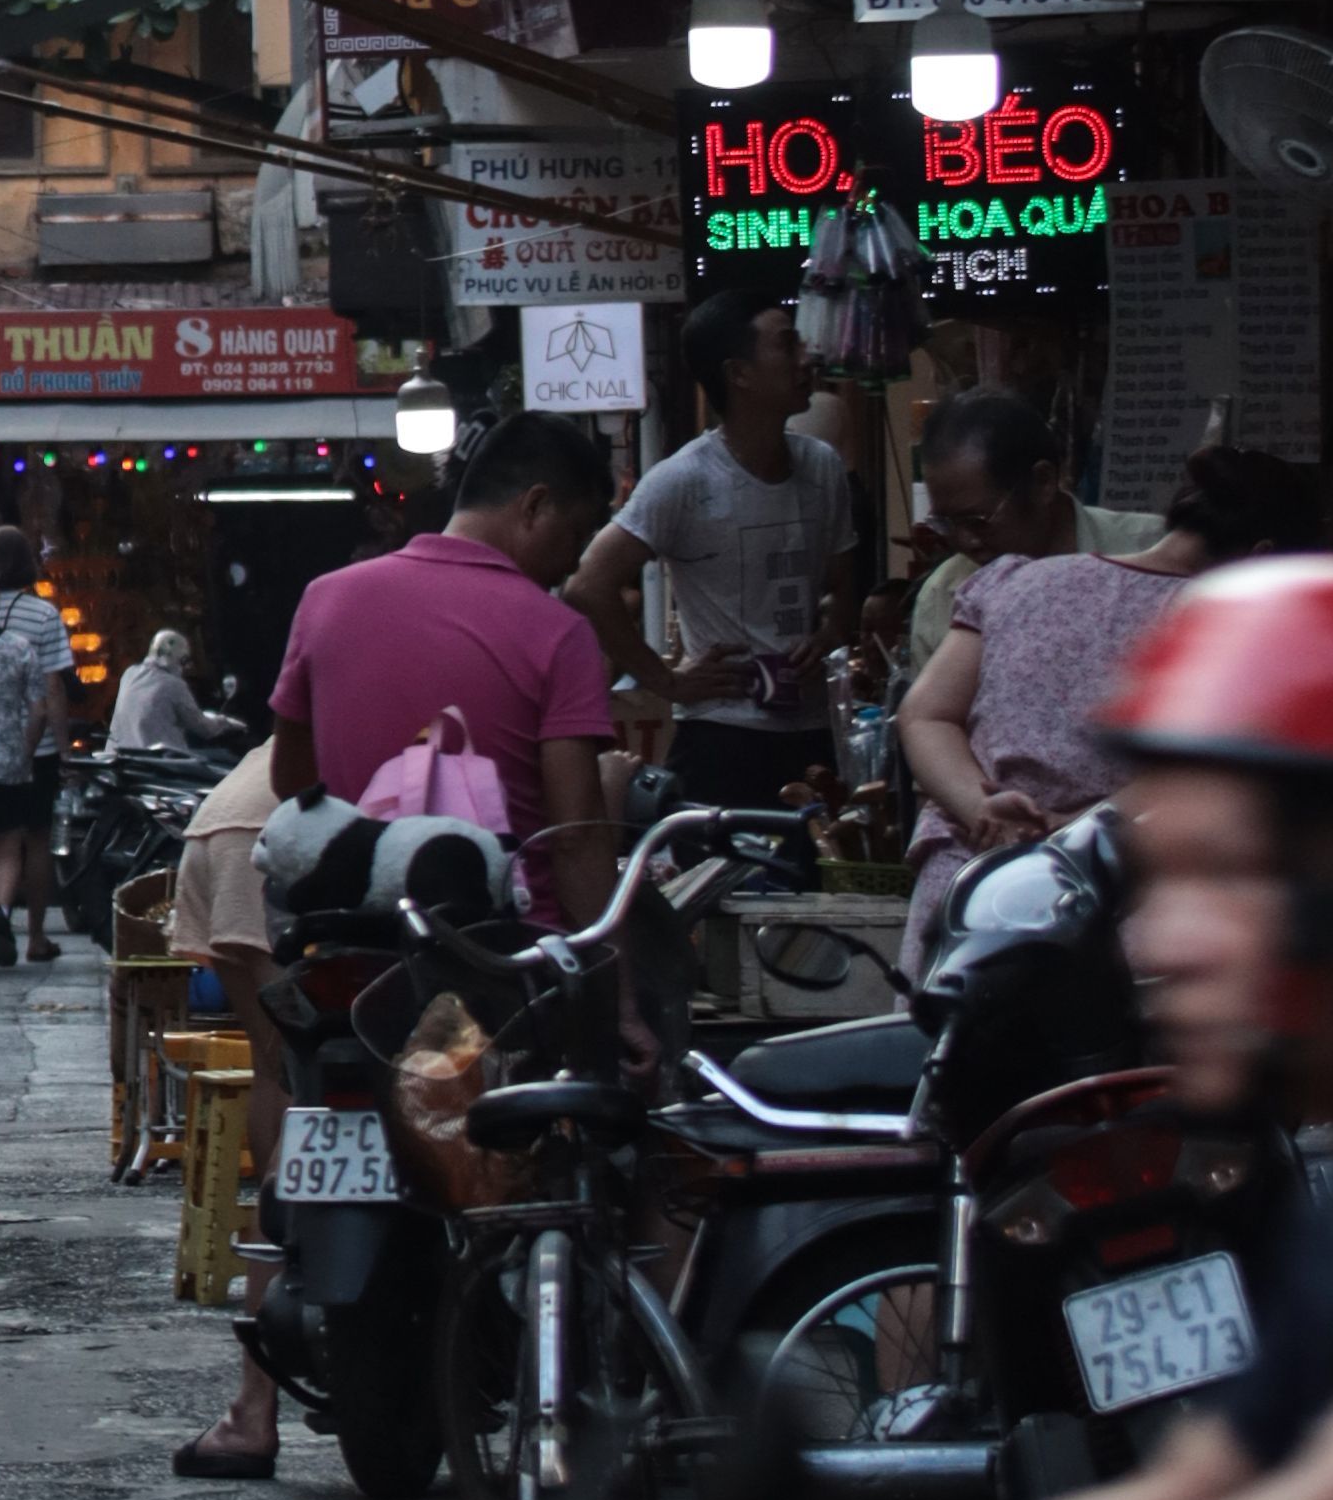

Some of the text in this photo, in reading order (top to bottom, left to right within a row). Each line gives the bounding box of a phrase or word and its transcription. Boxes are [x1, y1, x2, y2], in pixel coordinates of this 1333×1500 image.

[705, 94, 1114, 196] HO BÉO
[918, 198, 1015, 241] HOA
[3, 312, 156, 362] THUẦN
[174, 317, 214, 359] 8
[219, 324, 280, 357] HÀNG
[29, 370, 93, 394] PHONG
[282, 377, 314, 391] 119
[535, 379, 634, 402] CHIC NAIL
[300, 1114, 378, 1153] 29-C
[1090, 1268, 1216, 1344] 29-C1
[1091, 1315, 1246, 1402] 754.73
